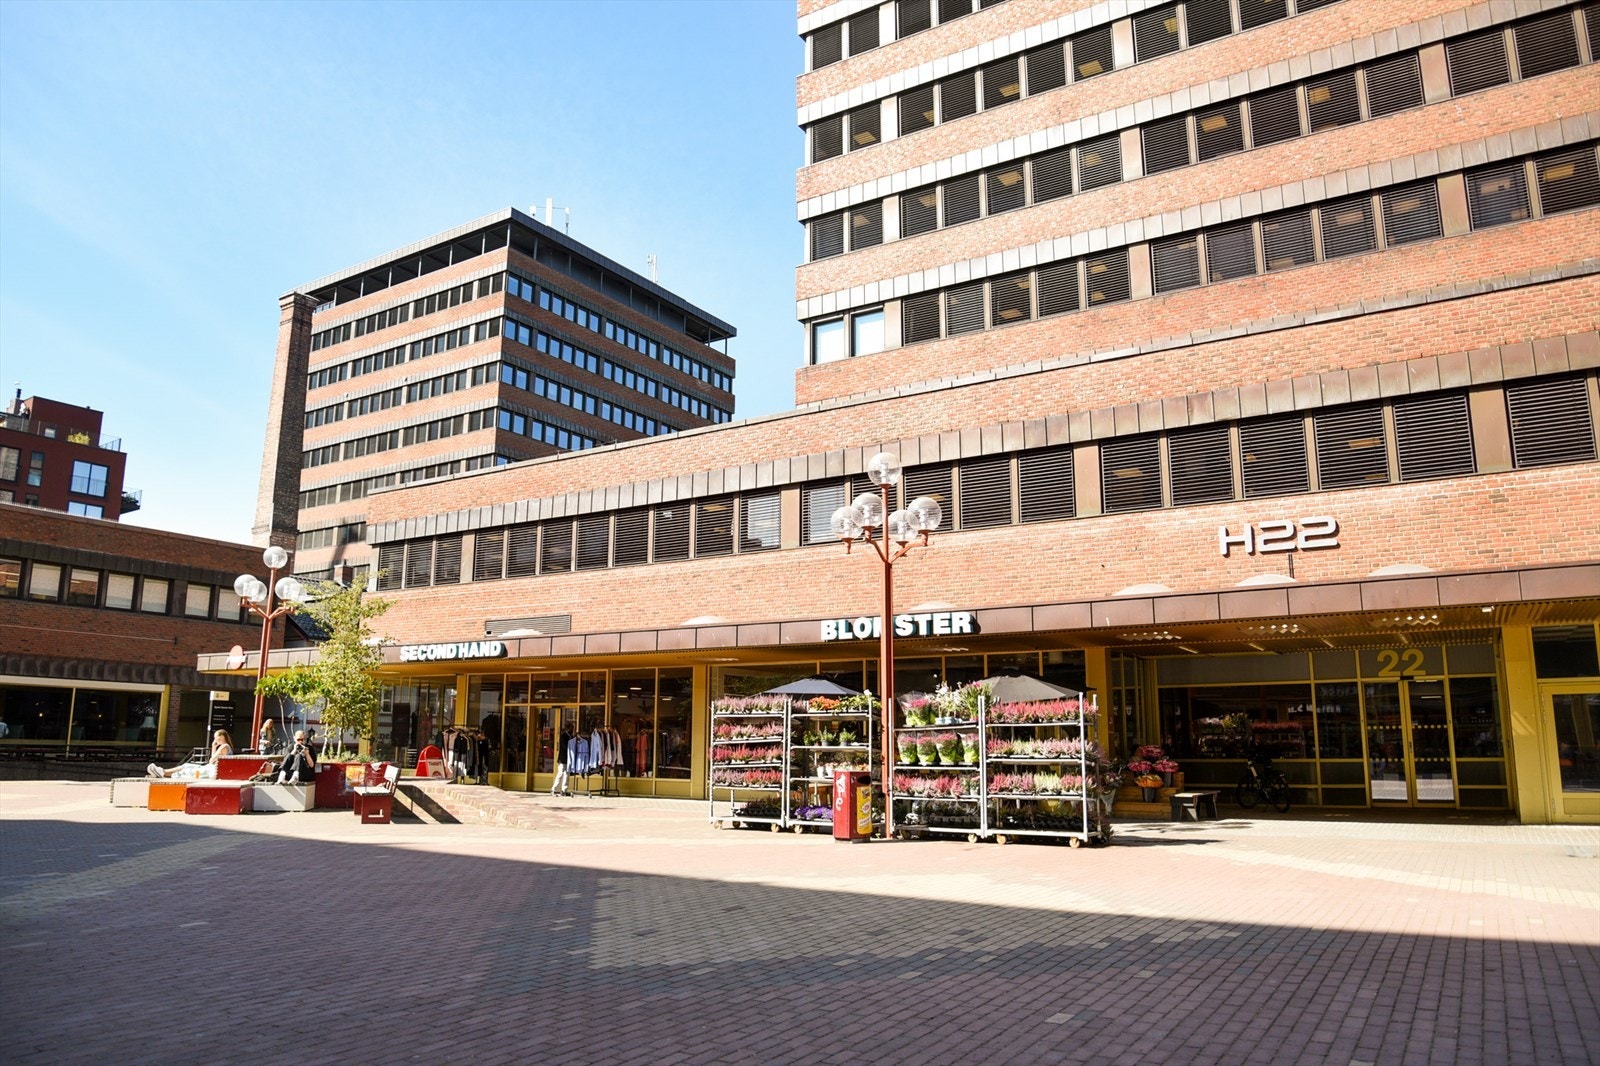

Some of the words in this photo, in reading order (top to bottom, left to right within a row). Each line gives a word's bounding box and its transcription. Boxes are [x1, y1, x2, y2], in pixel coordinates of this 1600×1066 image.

[1219, 515, 1340, 556] H22
[399, 643, 457, 662] SECOND
[458, 640, 502, 659] HAND
[1376, 648, 1427, 677] 22
